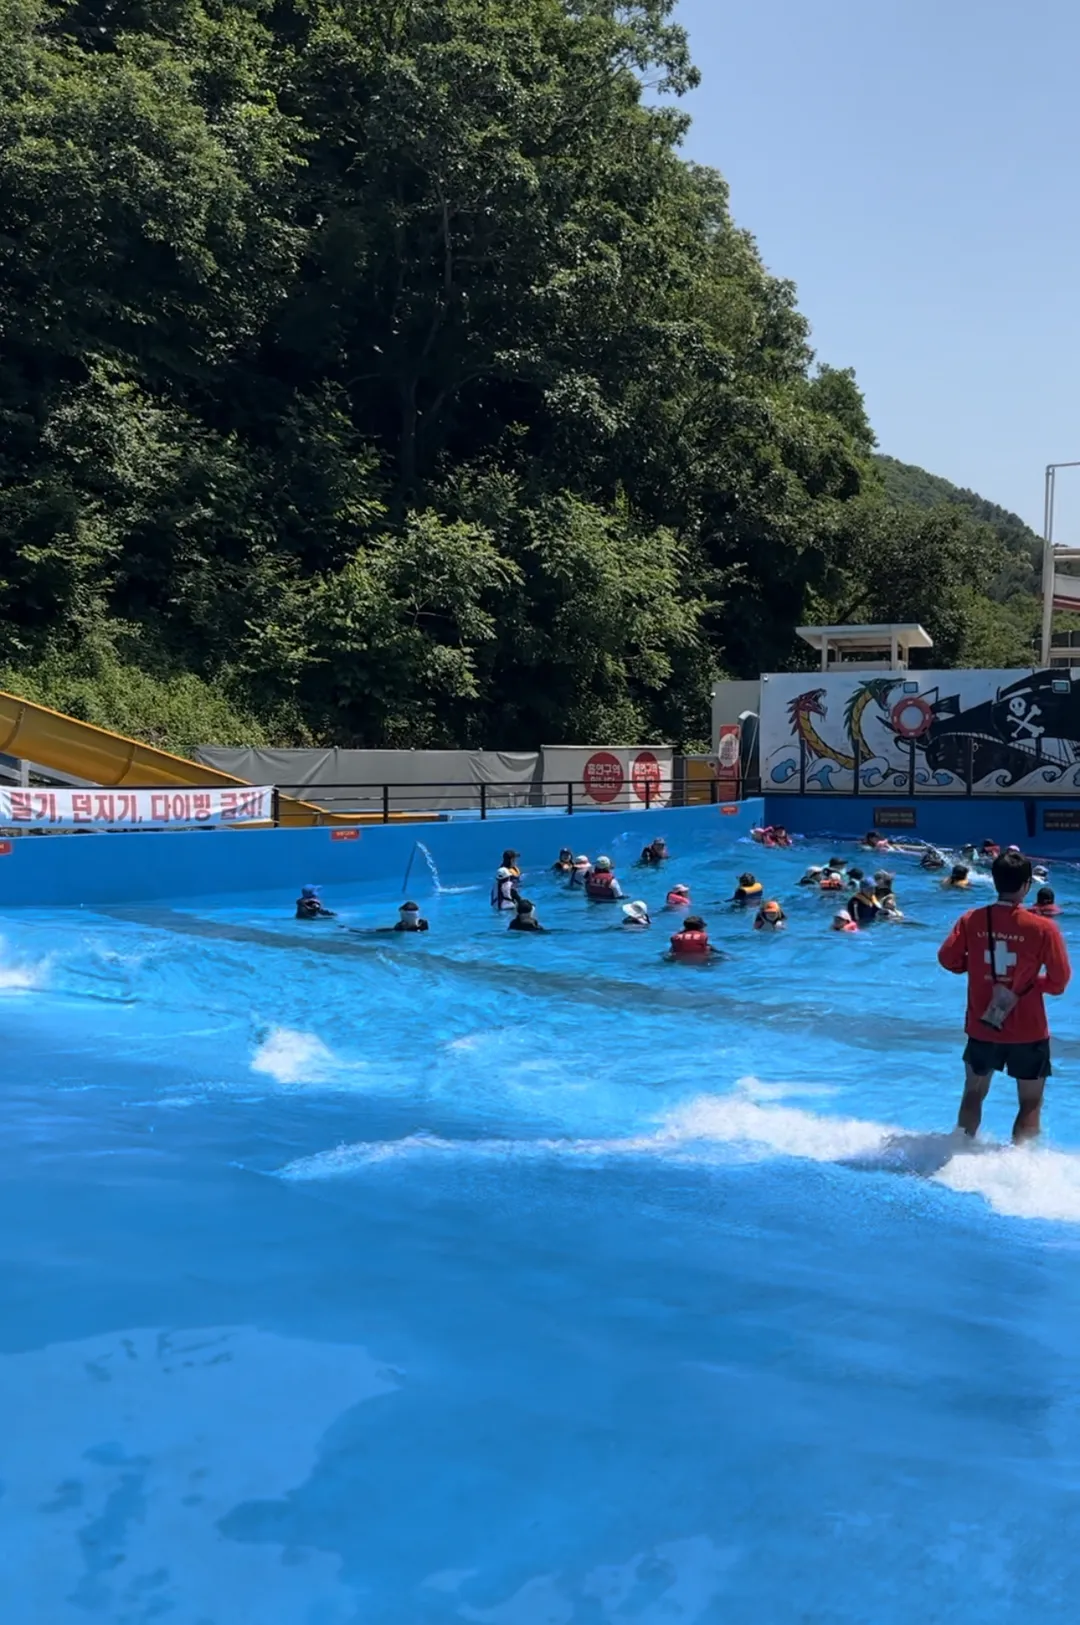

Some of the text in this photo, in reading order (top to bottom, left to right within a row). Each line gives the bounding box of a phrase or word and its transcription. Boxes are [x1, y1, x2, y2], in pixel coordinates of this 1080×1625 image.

[10, 790, 263, 824] 밀기, 던지기, 다이빙 금지!
